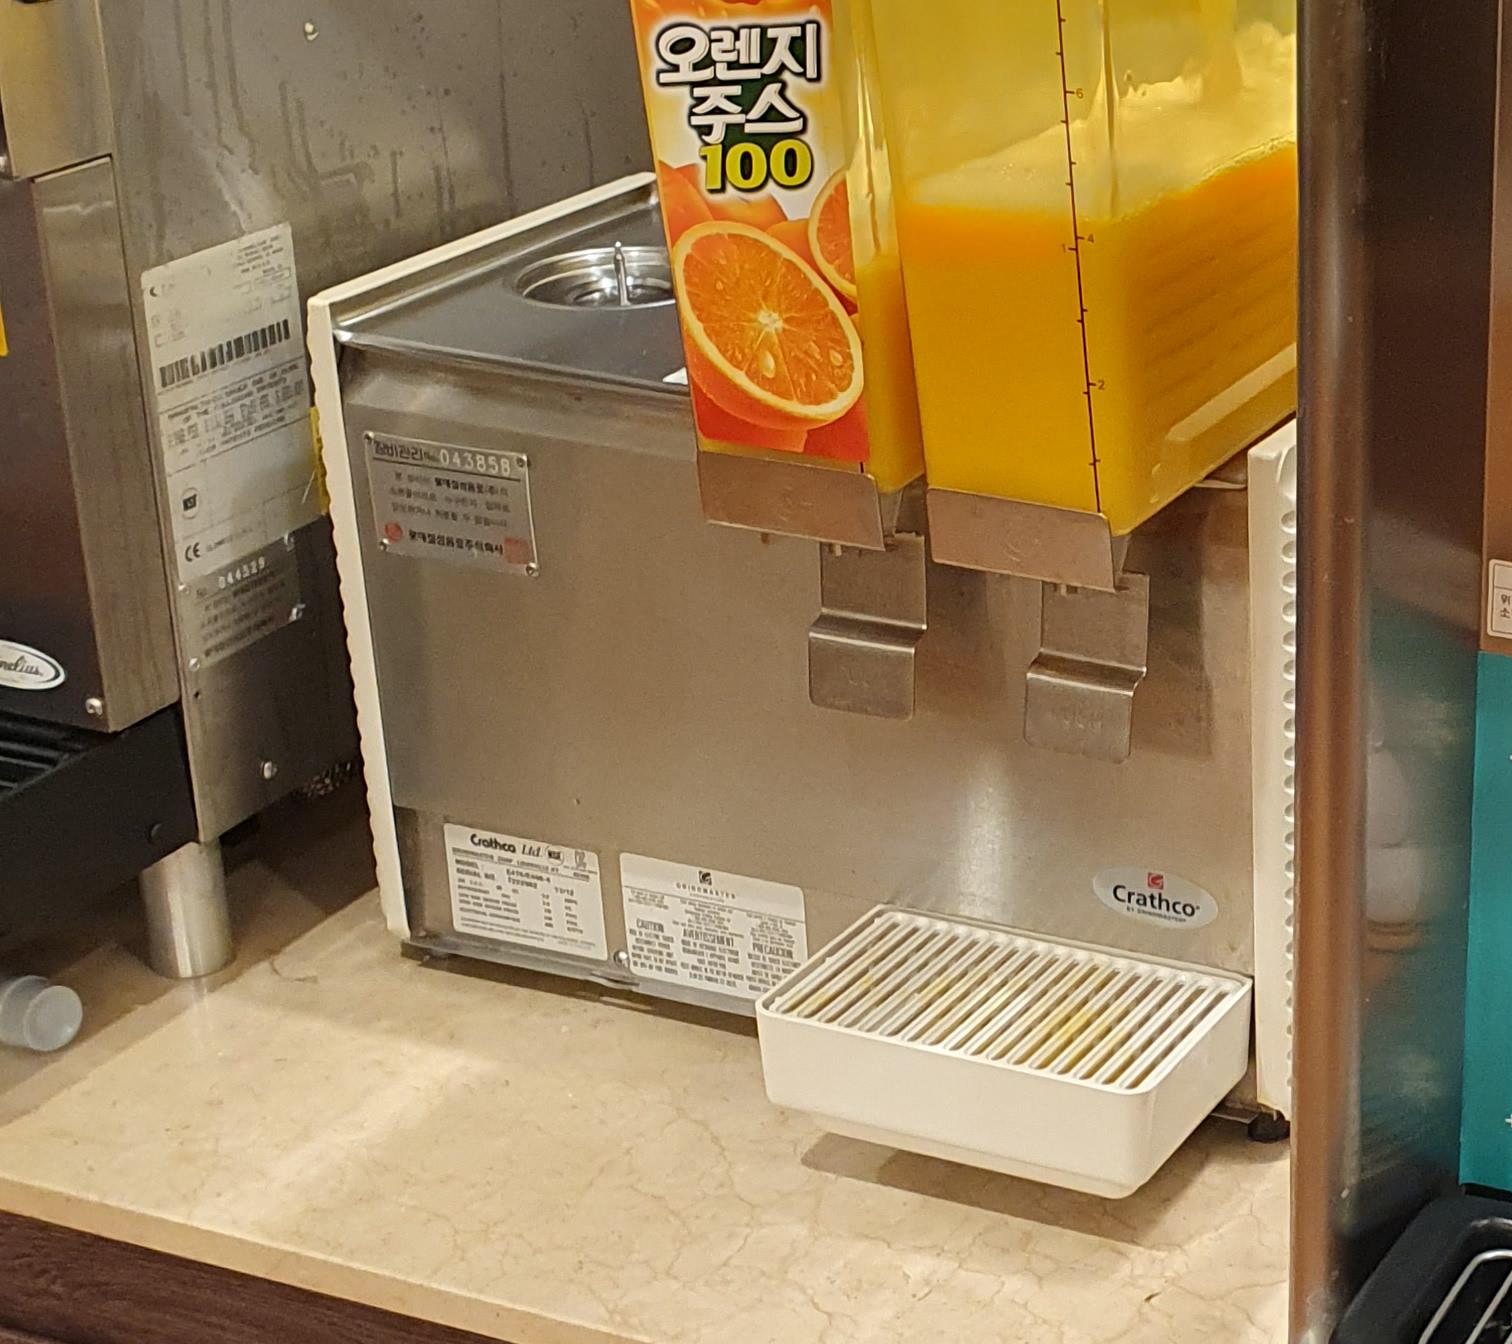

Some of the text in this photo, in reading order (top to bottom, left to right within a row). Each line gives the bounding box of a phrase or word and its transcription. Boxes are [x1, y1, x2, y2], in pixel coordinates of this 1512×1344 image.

[657, 20, 820, 87] 오렌지
[689, 84, 804, 144] 주스
[699, 141, 814, 193] 100
[439, 449, 512, 476] 043858
[470, 833, 516, 854] Crathco
[1113, 884, 1196, 917] Crathco
